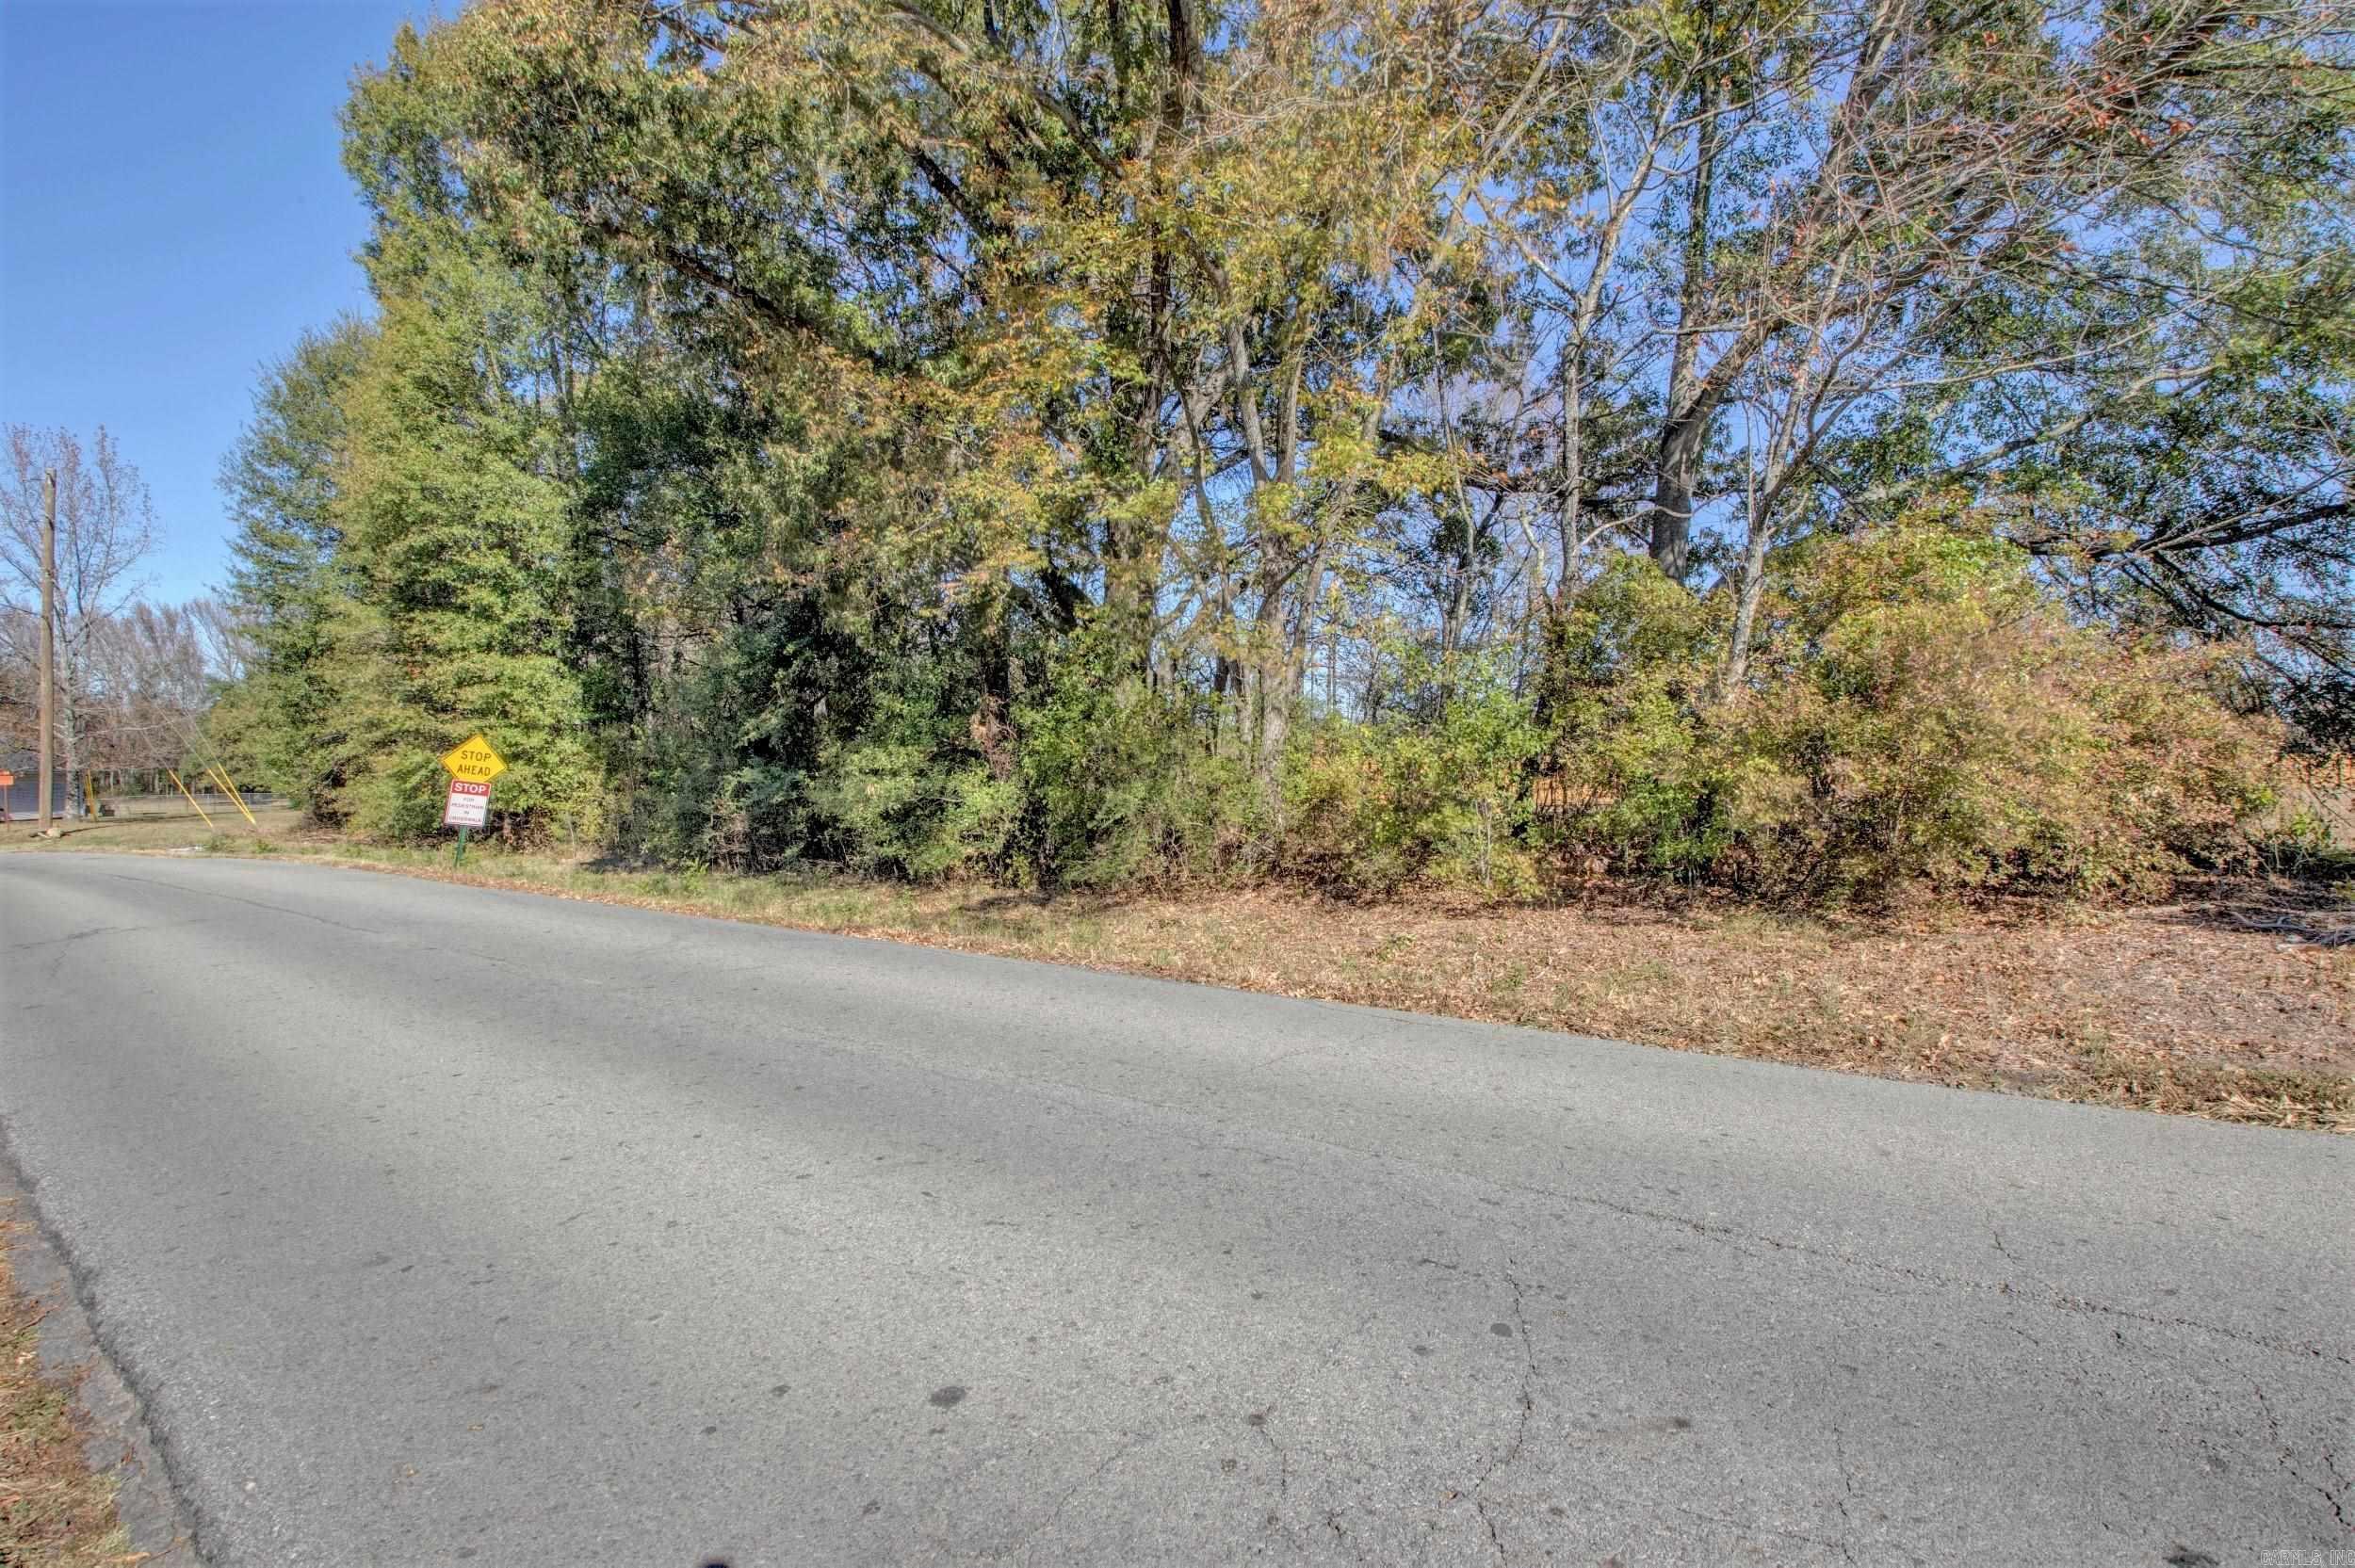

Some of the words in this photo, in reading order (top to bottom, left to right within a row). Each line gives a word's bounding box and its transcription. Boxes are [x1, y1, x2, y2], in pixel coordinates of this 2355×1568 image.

[461, 750, 492, 762] STOP
[457, 764, 491, 777] AHEAD
[454, 782, 487, 794] STOP
